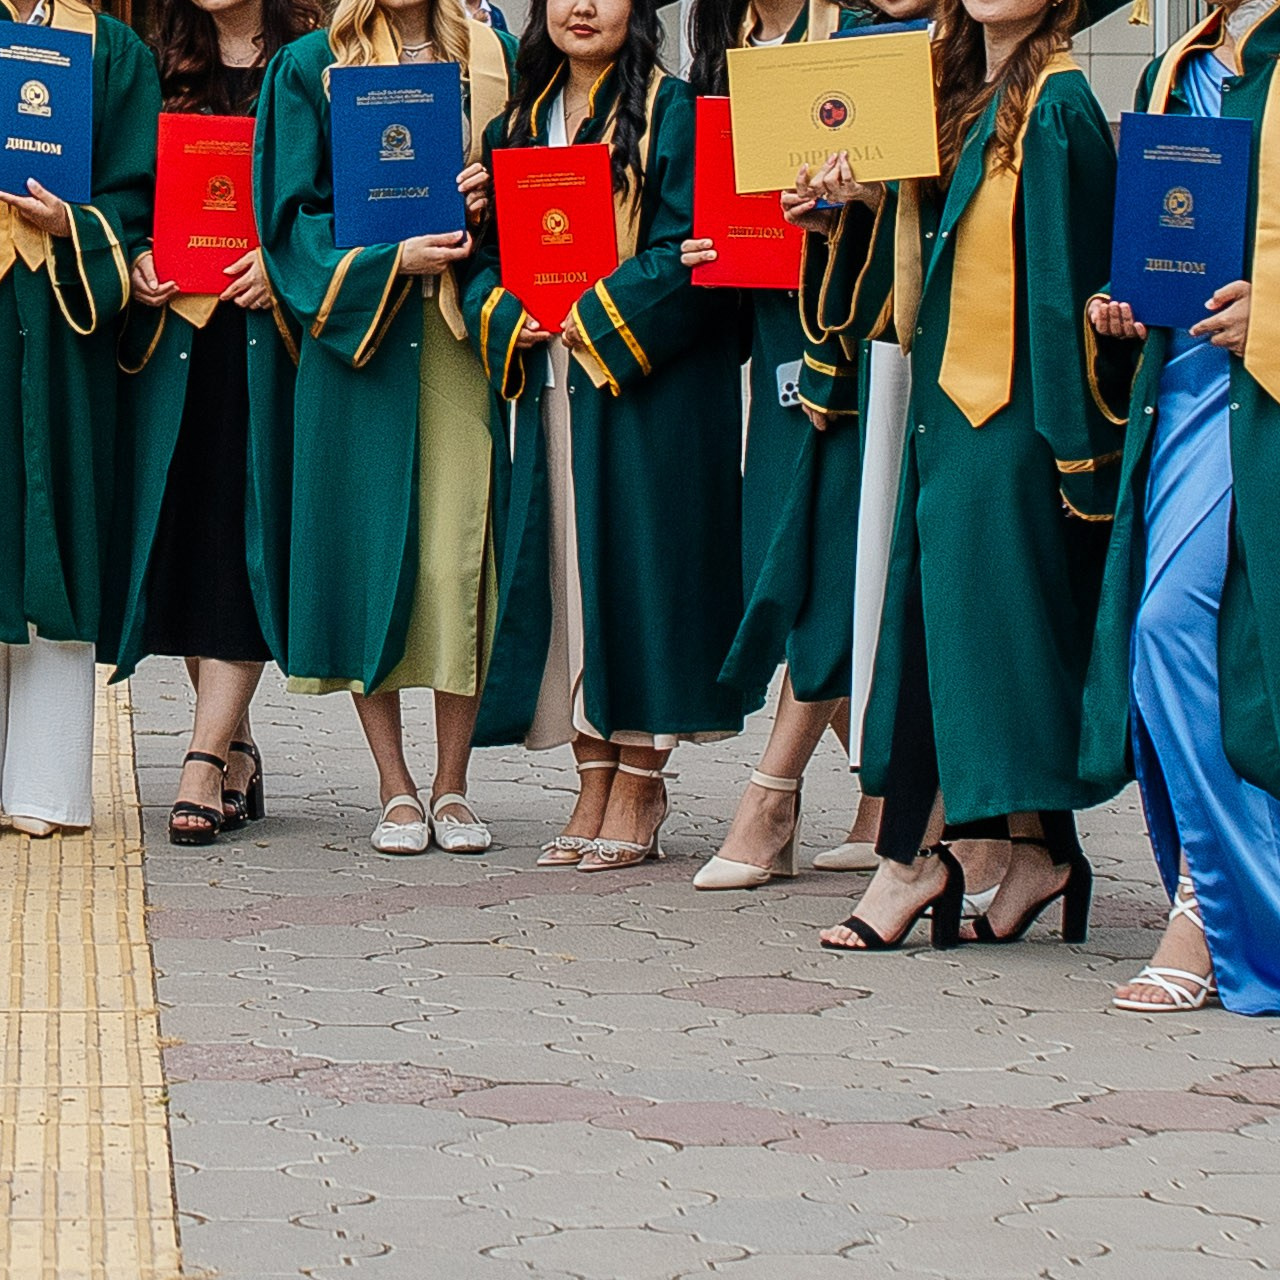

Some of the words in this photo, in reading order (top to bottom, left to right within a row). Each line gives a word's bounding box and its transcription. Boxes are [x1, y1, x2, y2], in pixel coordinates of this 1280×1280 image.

[5, 137, 62, 155] ДИПЛОМ
[187, 235, 248, 249] ДИПЛОМ
[534, 272, 587, 286] ДИПЛОМ
